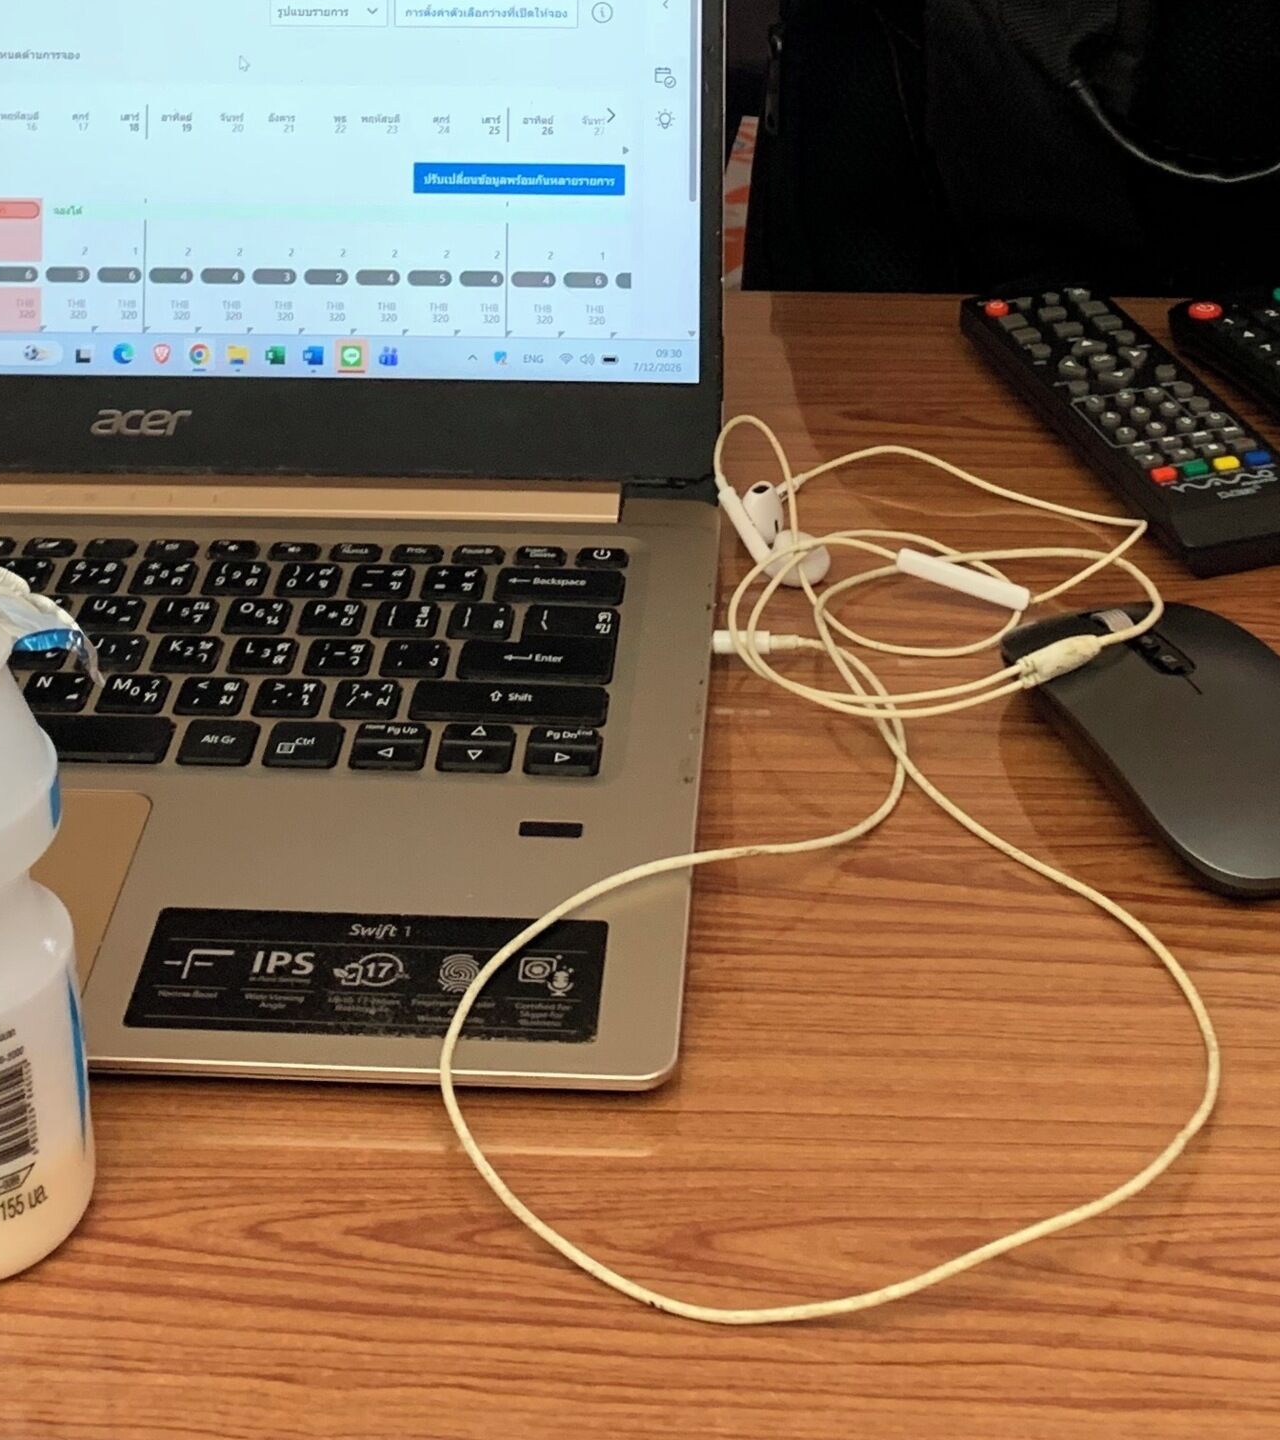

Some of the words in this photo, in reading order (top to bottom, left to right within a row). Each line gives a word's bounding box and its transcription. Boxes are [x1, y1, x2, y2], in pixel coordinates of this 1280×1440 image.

[277, 6, 349, 19] รูปแบบรายการ
[182, 123, 192, 133] 19
[488, 126, 501, 135] 25
[541, 127, 554, 136] 26
[423, 171, 616, 188] ปรับเปลี่ยนข้อมูลพร้อมกันหลายรายการ
[523, 354, 544, 364] ENG
[633, 363, 682, 373] 7/12/2026
[90, 409, 192, 436] acer
[533, 577, 587, 587] Backspace
[93, 599, 108, 610] U
[240, 602, 255, 613] O
[314, 604, 326, 615] P
[170, 640, 182, 652] K
[245, 642, 254, 653] L
[534, 653, 564, 663] Enter
[36, 676, 54, 688] N
[113, 678, 132, 690] M
[508, 692, 533, 702] Shift
[386, 726, 400, 735] Pg
[402, 726, 418, 734] Up
[546, 730, 560, 740] Pg
[562, 731, 577, 739] Dn
[577, 729, 593, 737] End
[201, 734, 218, 744] Alt
[221, 735, 236, 744] Gr
[294, 737, 316, 746] Ctrl
[348, 924, 398, 939] Swift
[251, 950, 316, 975] IPS
[366, 962, 393, 978] 17
[0, 1193, 25, 1221] 155
[28, 1184, 49, 1209] มล.
